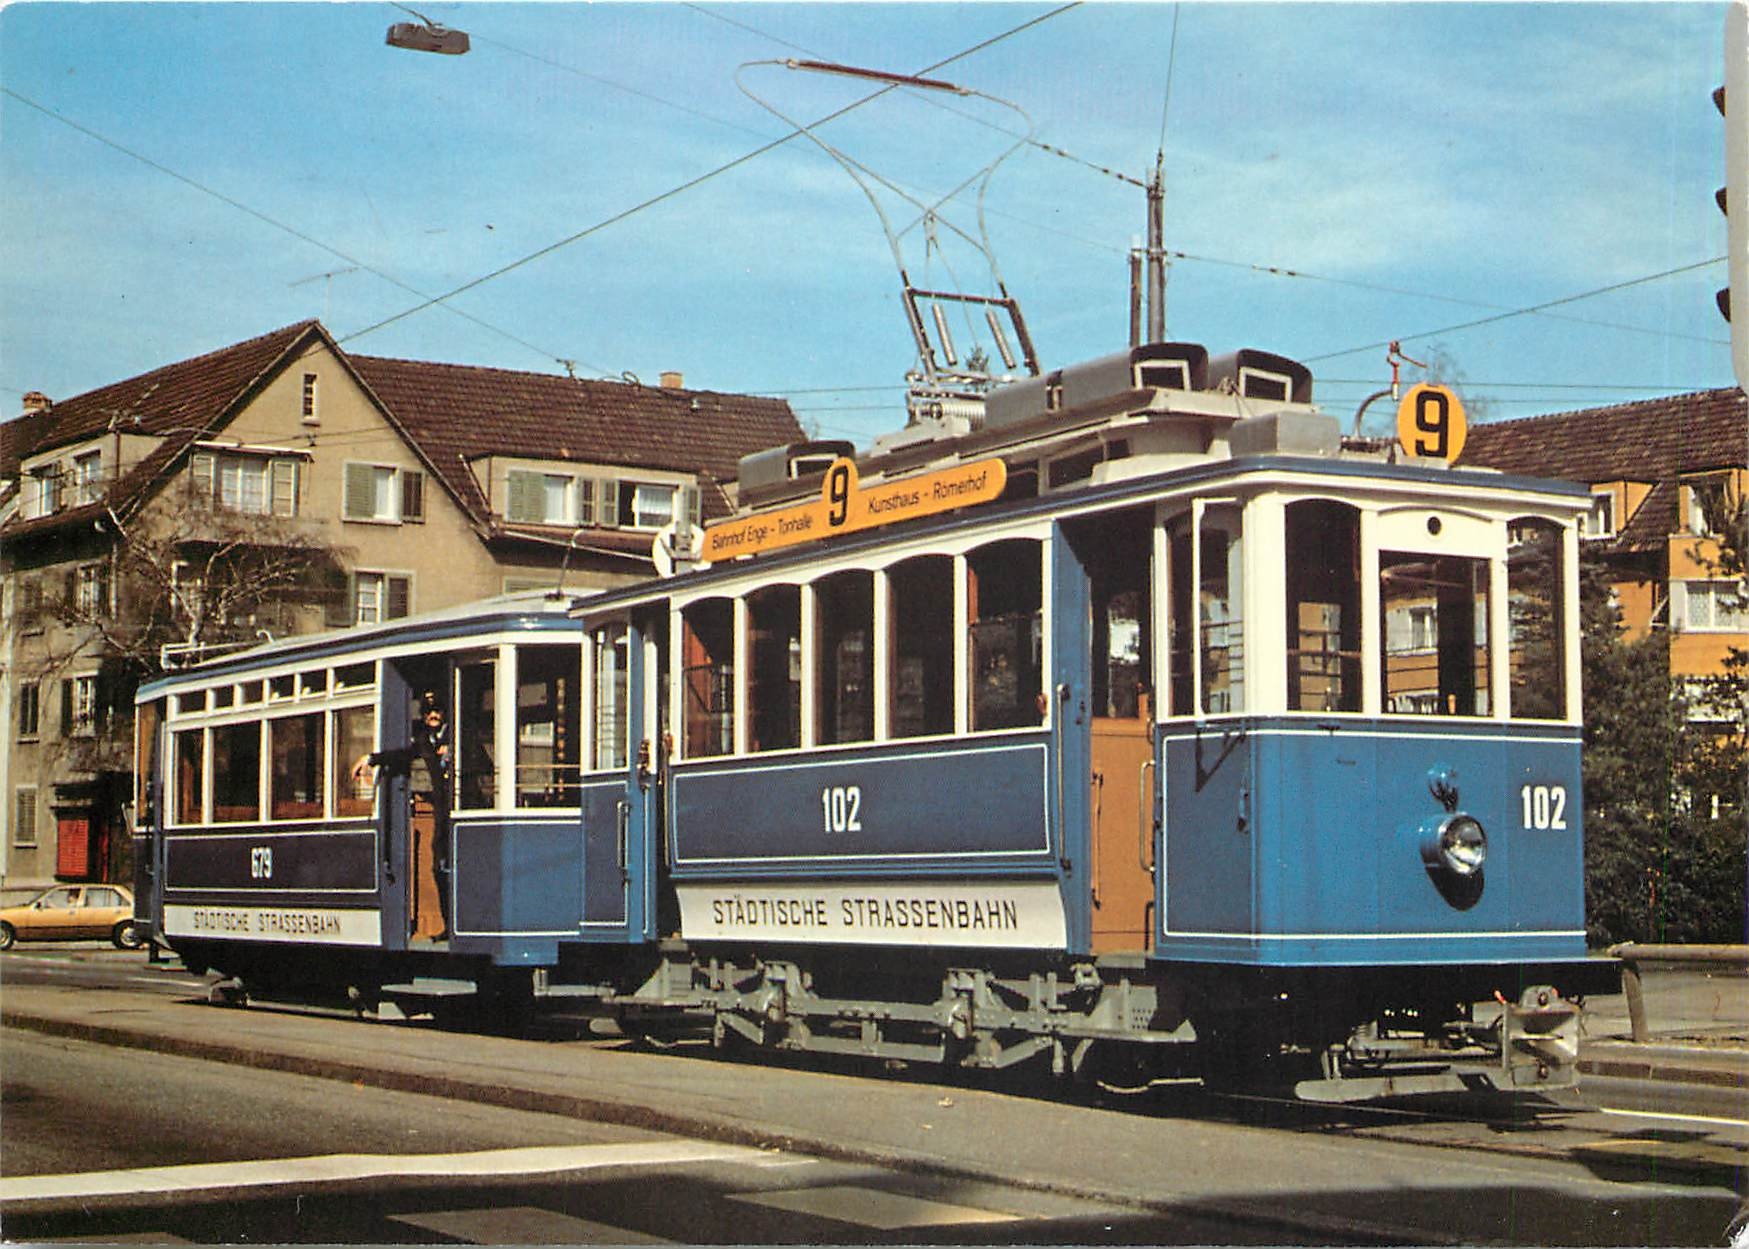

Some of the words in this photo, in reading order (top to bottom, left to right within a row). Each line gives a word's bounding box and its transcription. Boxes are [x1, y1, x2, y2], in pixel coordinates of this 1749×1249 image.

[1416, 390, 1449, 457] 9
[829, 465, 849, 527] 9
[868, 489, 919, 514] Kunsthaus
[933, 470, 987, 499] Römerhof
[712, 526, 745, 550] Bahnhof
[747, 525, 767, 544] Enge
[778, 513, 813, 535] Tonhalle
[822, 786, 861, 832] 102
[1521, 784, 1566, 830] 102
[251, 847, 272, 878] 679
[195, 910, 249, 932] STÄDTISCHE
[259, 912, 341, 934] STRASSENBAHN
[713, 894, 828, 925] STÄDTISCHE
[842, 899, 1018, 930] STRASSENBAHN
